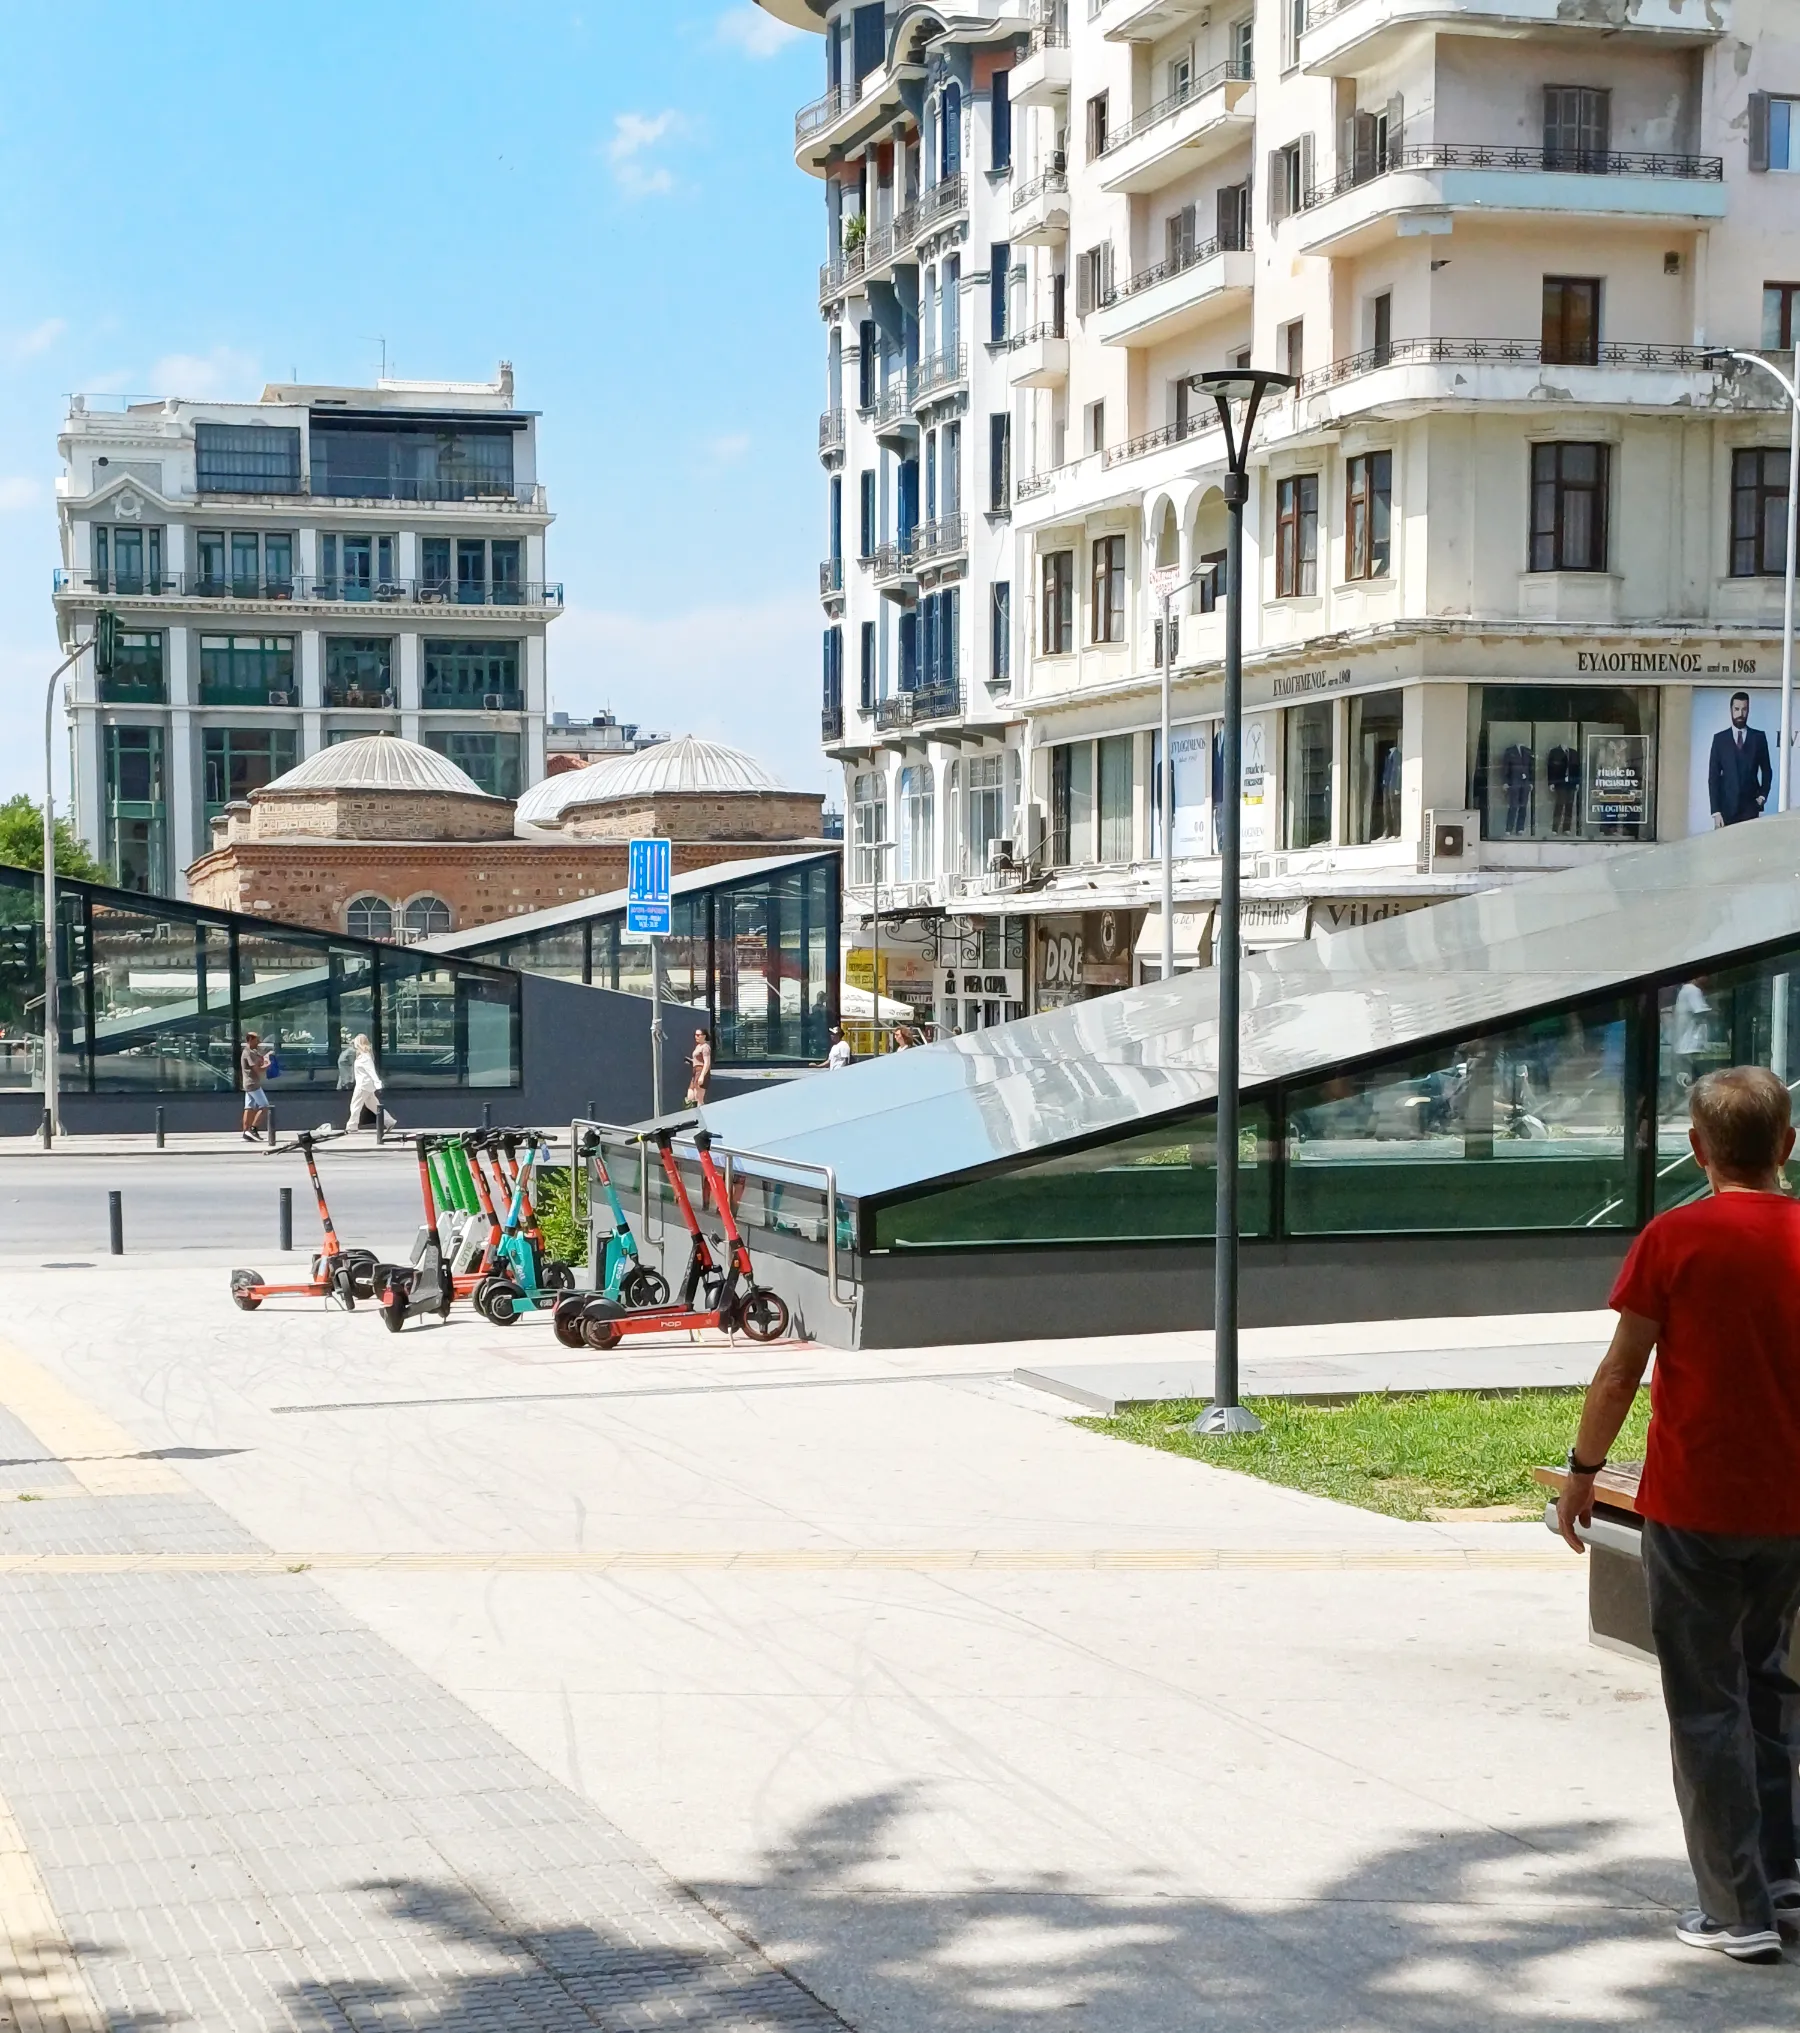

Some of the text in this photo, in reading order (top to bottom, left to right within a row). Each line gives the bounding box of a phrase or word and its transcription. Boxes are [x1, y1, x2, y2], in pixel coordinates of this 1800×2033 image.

[1577, 652, 1702, 673] ΕΥΛΟΓΗΜΕΝΟΣ
[1732, 658, 1756, 673] 1968
[1626, 769, 1635, 777] to
[1240, 902, 1290, 926] ildiridis
[660, 1320, 682, 1328] hop
